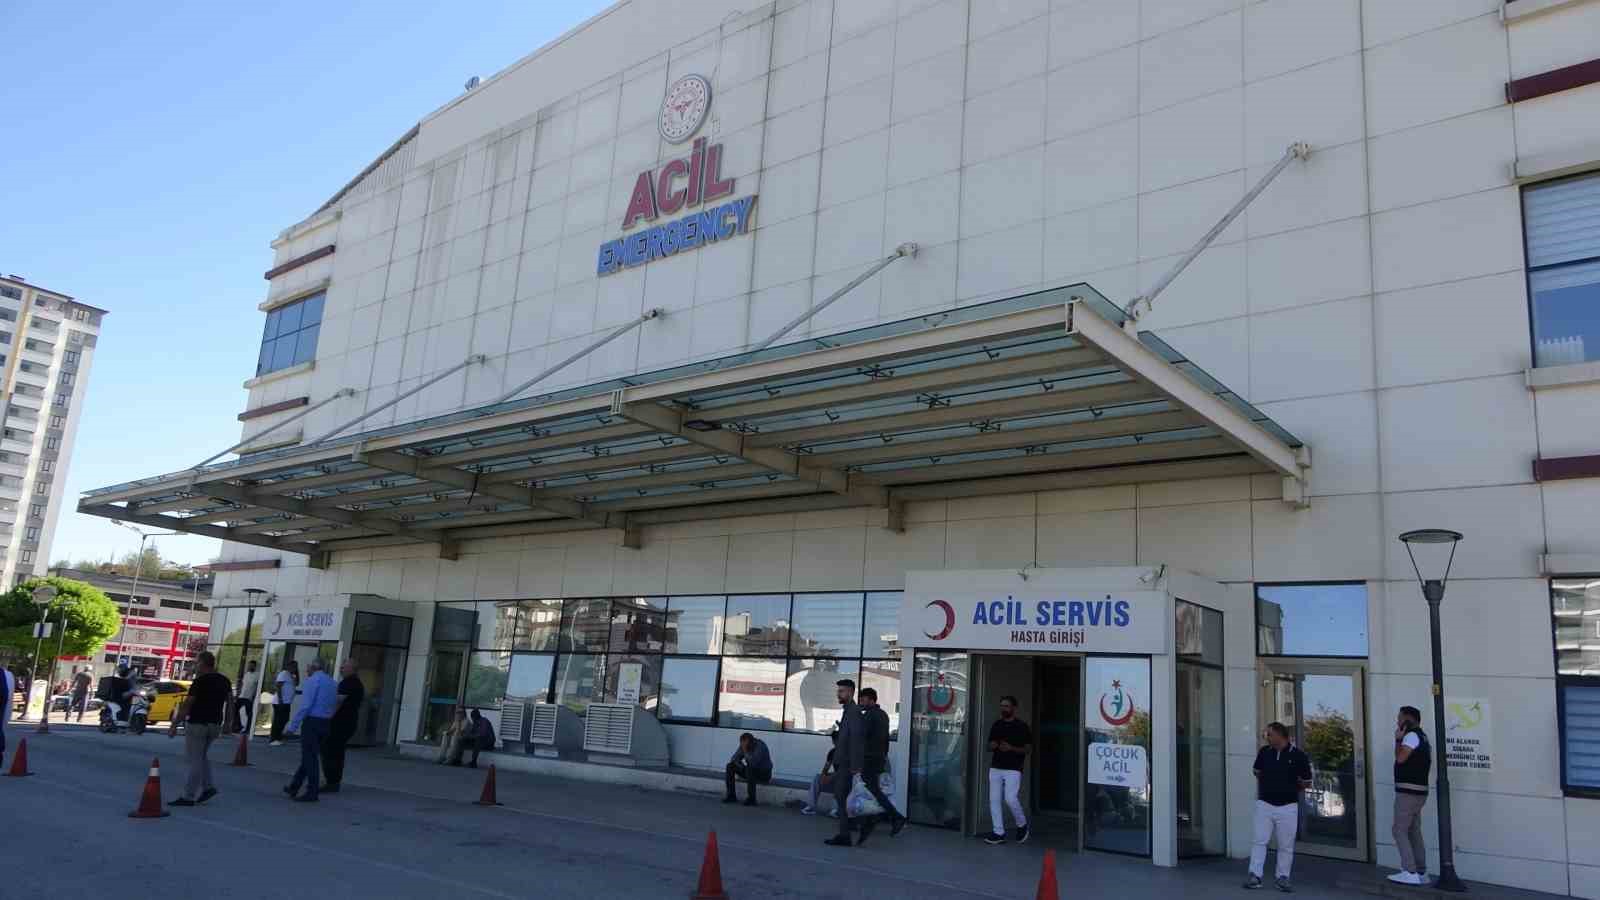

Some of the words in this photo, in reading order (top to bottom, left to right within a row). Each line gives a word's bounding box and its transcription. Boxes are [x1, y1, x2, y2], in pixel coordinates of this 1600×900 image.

[622, 137, 735, 230] ACİL
[597, 195, 759, 277] EMERGENCY
[972, 595, 1027, 625] ACİL
[1036, 594, 1130, 627] SERVİS
[1010, 630, 1046, 644] HASTA
[1049, 628, 1085, 648] GİRİŞİ
[1095, 745, 1138, 760] ÇOCUK
[1103, 760, 1132, 774] ACİL
